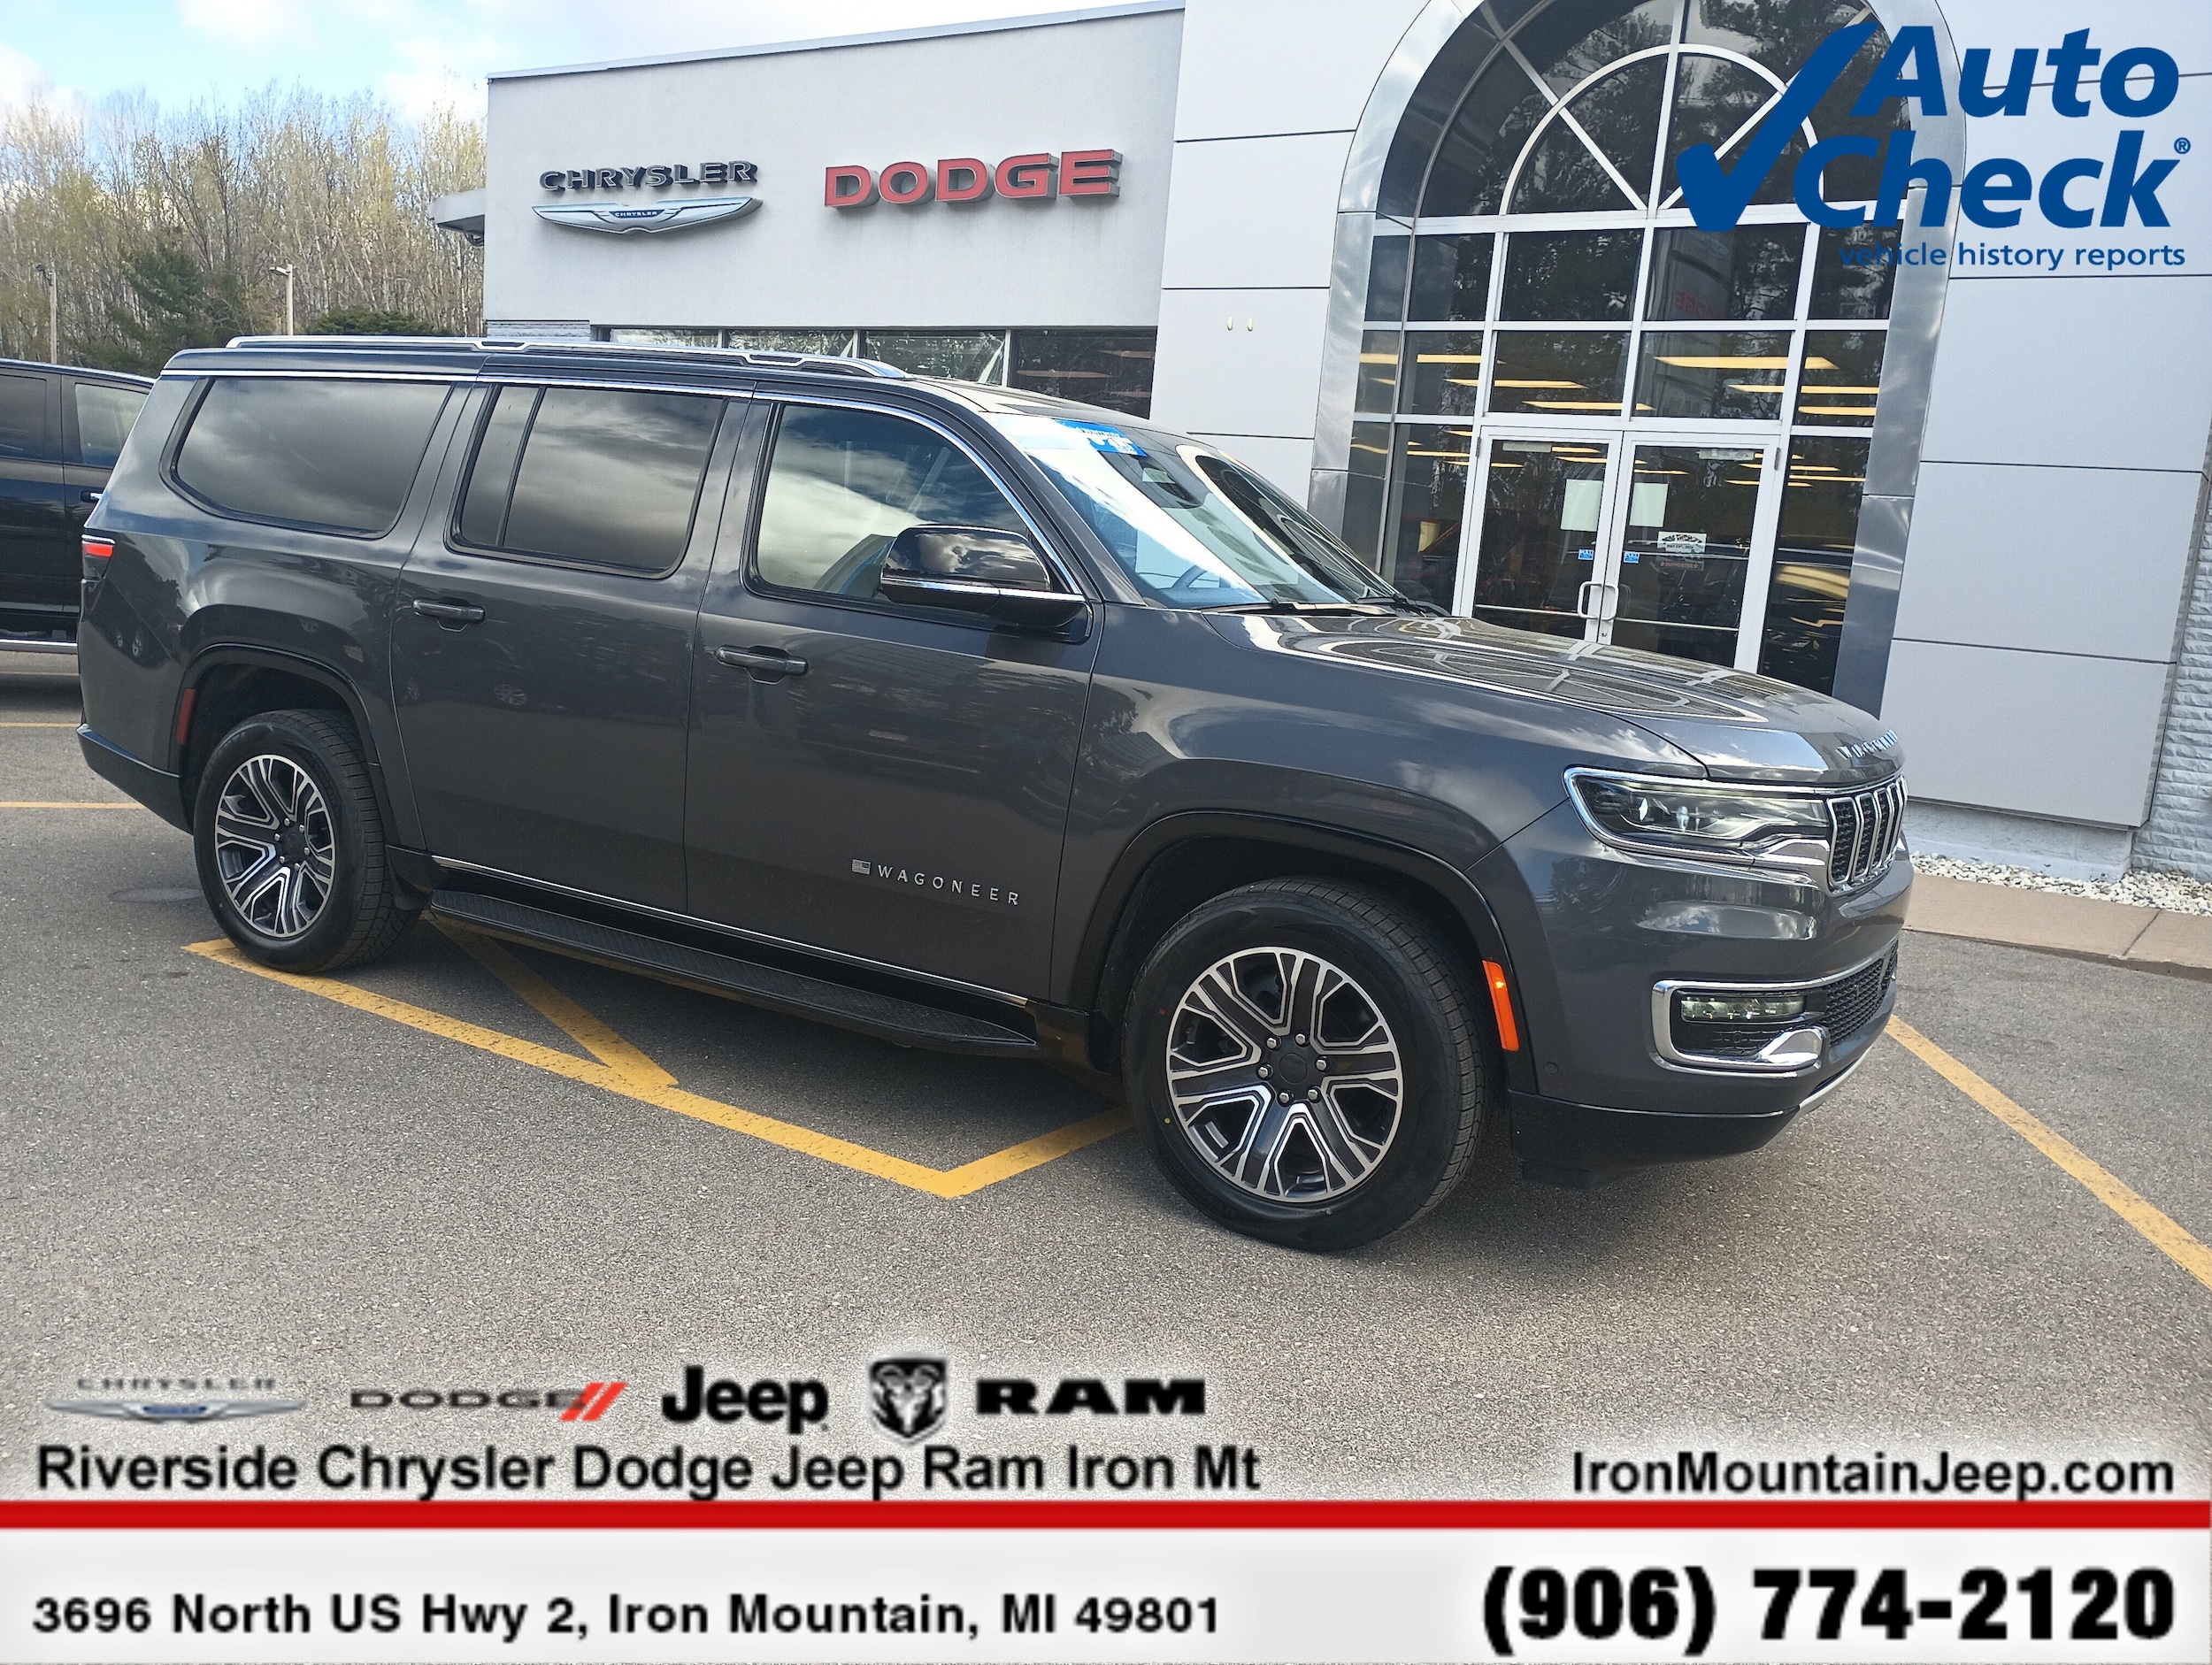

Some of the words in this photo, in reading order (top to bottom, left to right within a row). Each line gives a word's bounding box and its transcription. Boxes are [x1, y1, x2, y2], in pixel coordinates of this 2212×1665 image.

[539, 160, 758, 192] CHRYSLER
[824, 149, 1120, 209] DODGE
[877, 864, 1019, 906] WAGONEER
